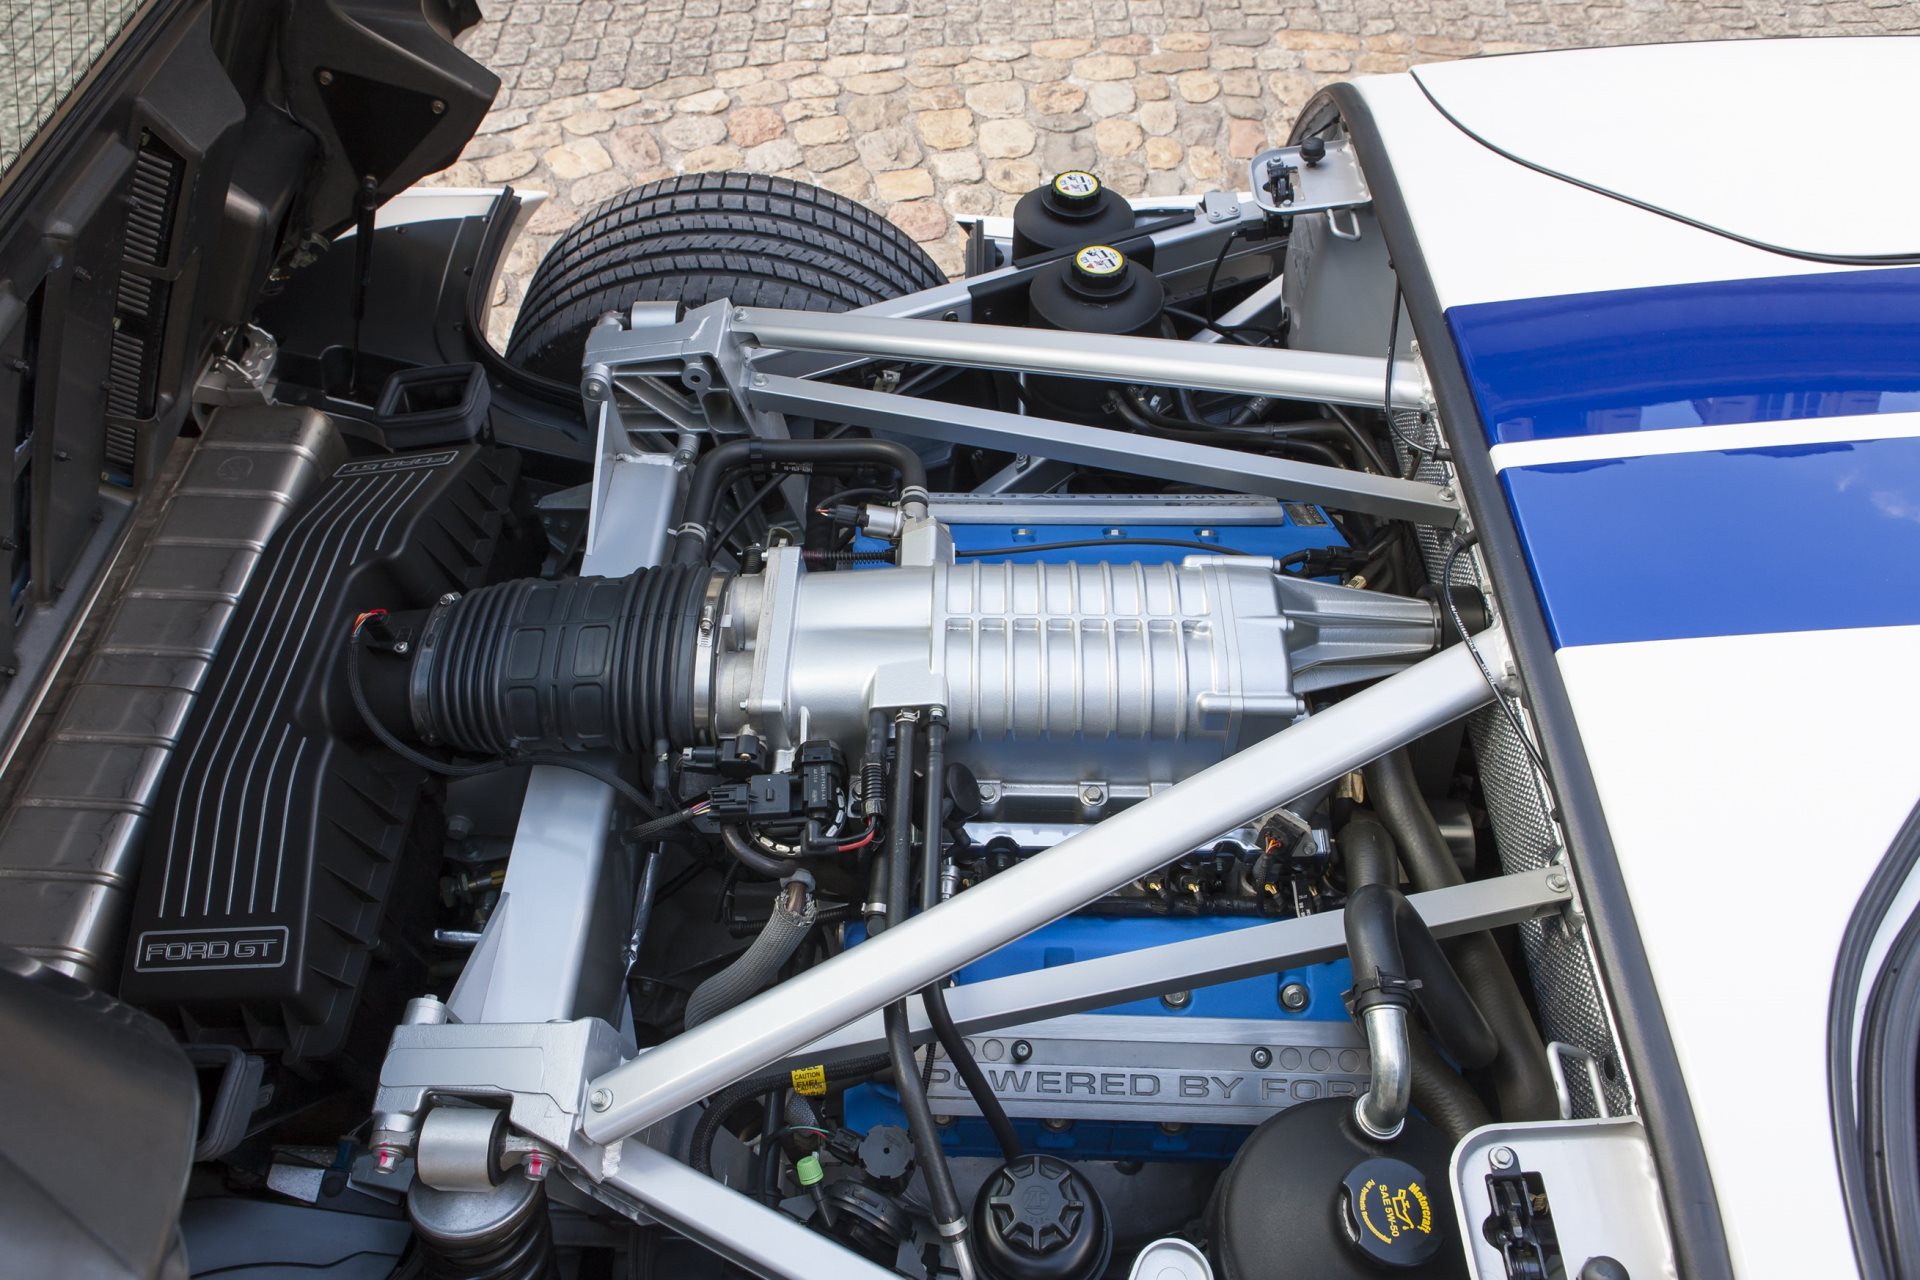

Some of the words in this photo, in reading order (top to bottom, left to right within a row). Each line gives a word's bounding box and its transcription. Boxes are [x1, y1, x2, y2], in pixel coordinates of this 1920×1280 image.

[146, 941, 229, 962] FORD
[234, 939, 278, 958] GT
[794, 1071, 821, 1081] CAUTION
[1179, 1075, 1244, 1099] BY
[1262, 1078, 1371, 1101] FOR
[1379, 1184, 1392, 1206] SAE
[1408, 1182, 1431, 1234] Motorcraft
[1384, 1207, 1400, 1238] 5W-50
